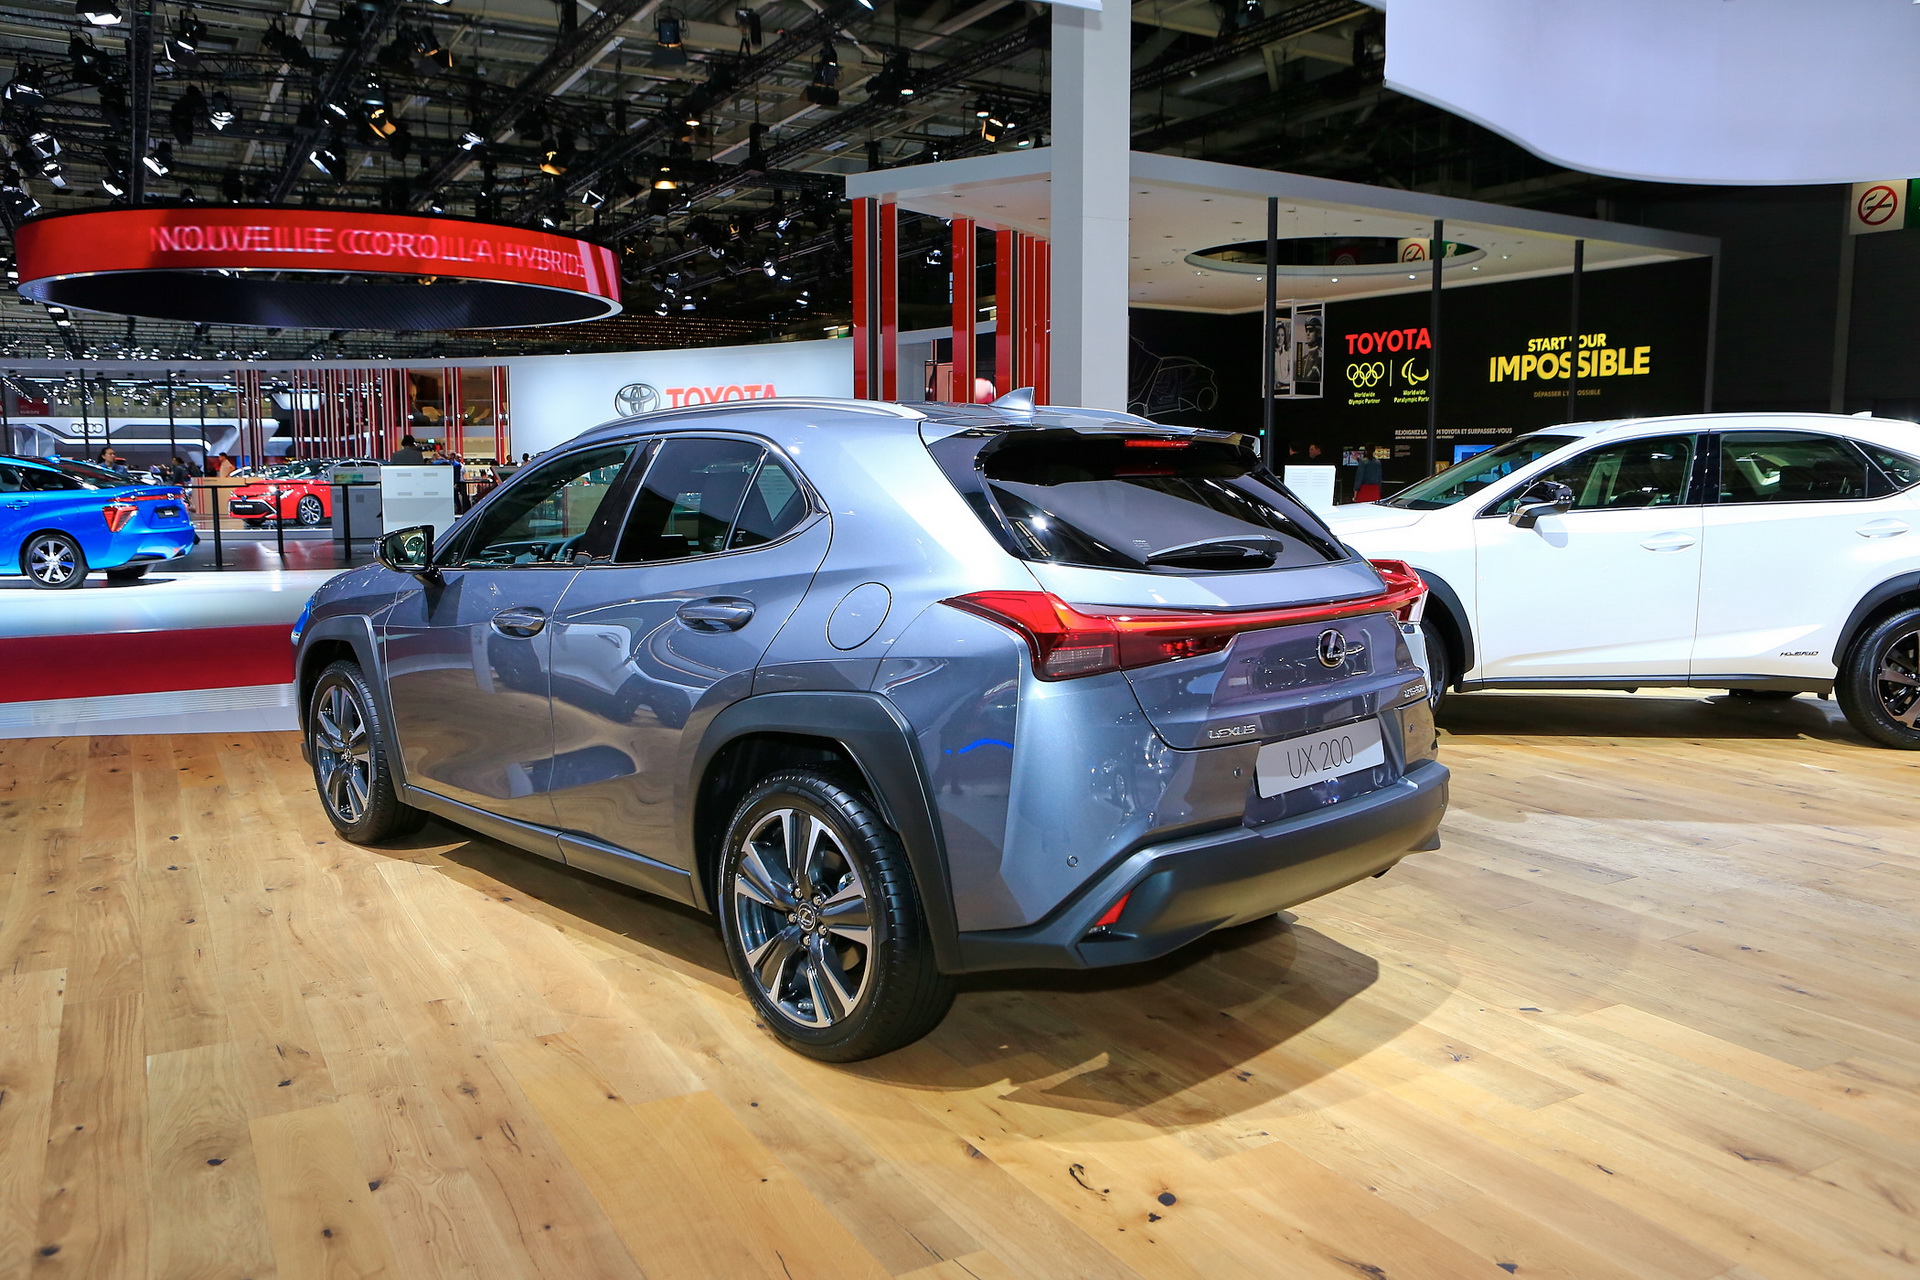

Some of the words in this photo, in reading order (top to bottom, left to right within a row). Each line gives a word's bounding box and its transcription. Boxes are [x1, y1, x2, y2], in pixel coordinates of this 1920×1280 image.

[1345, 327, 1432, 355] TOYOTA
[1528, 336, 1567, 352] START
[1568, 333, 1607, 349] OUR
[1489, 346, 1651, 382] IMPOSSIBLE
[665, 384, 777, 409] TOYOTA
[1209, 724, 1256, 739] LEXUS
[1286, 745, 1318, 779] UX
[1319, 735, 1354, 771] 200
